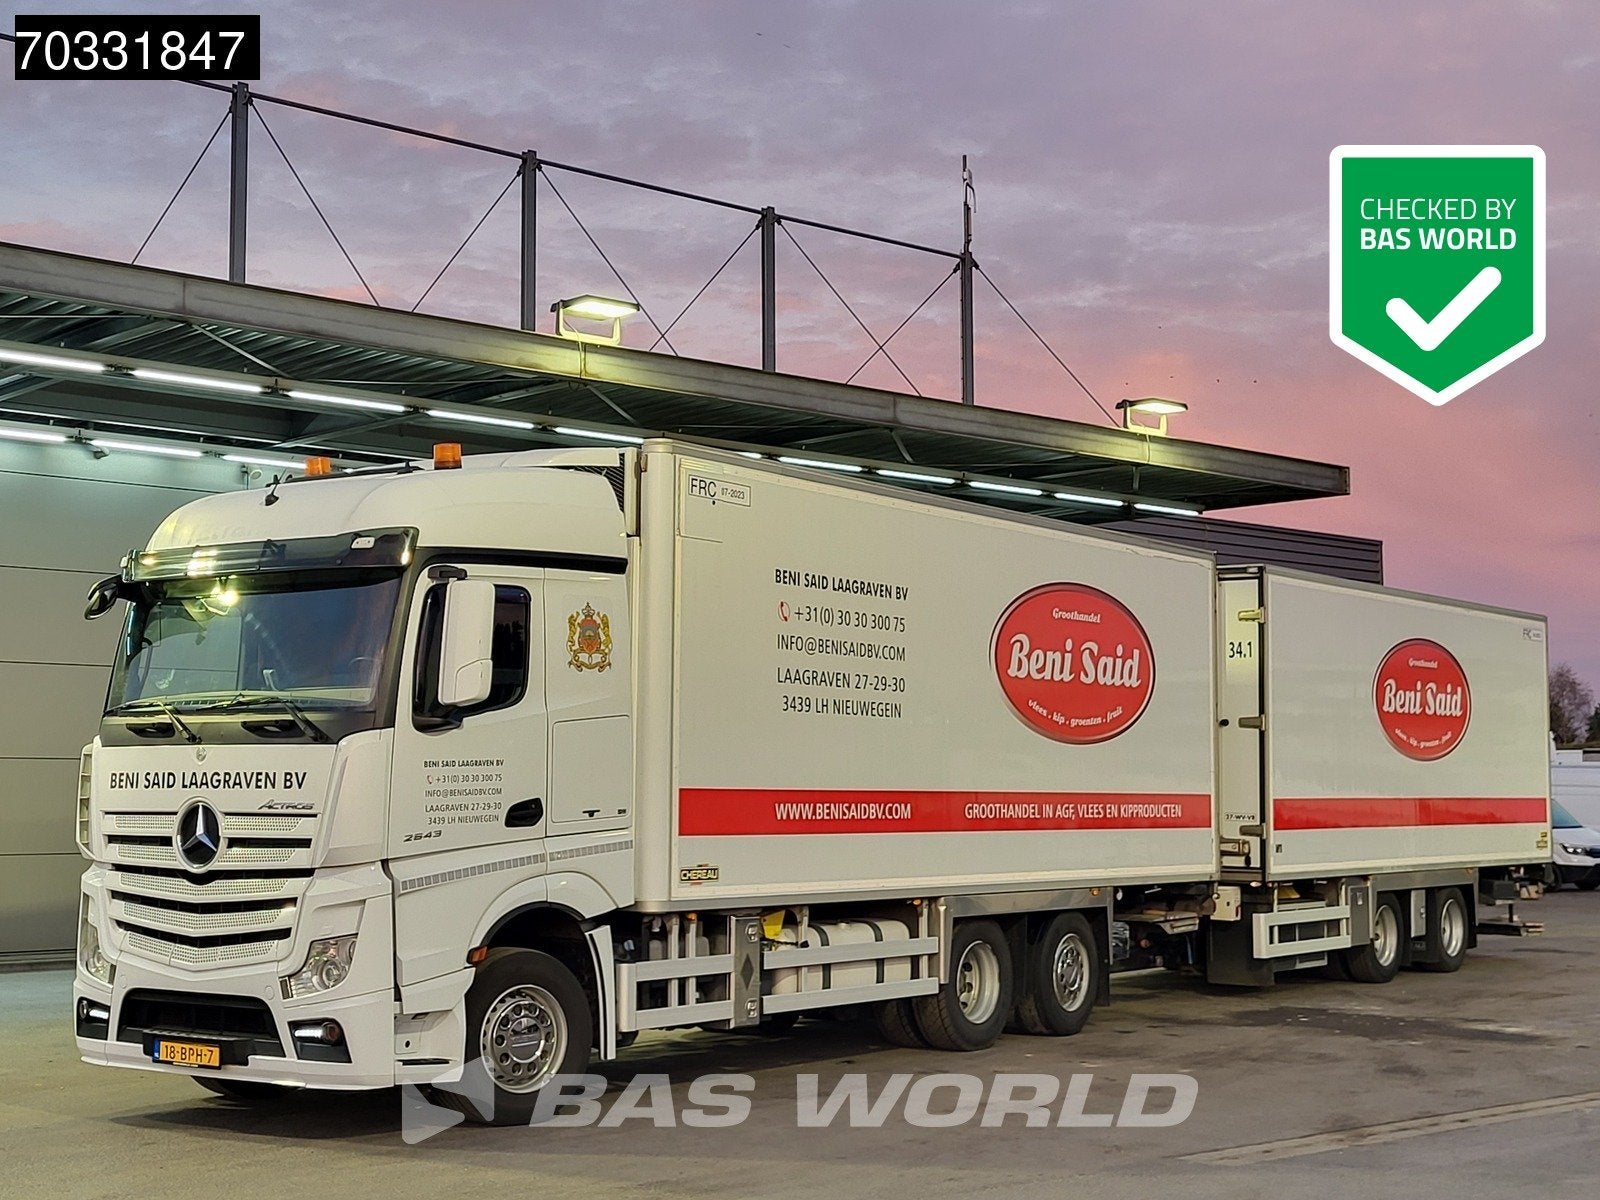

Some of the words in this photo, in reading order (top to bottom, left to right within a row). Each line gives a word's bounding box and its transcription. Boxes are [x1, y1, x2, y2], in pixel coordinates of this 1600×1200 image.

[690, 478, 717, 498] FRC
[775, 568, 800, 586] BENI
[804, 572, 829, 590] SAID
[832, 577, 892, 598] LAAGRAVEN
[895, 586, 909, 601] BV
[794, 605, 834, 627] +31(0)
[837, 609, 851, 626] 30
[854, 612, 868, 628] 30
[870, 614, 891, 631] 300
[893, 616, 906, 632] 75
[1052, 607, 1101, 624] Groothandel
[777, 634, 906, 661] INFO@BENISAIDBV.COM
[1228, 641, 1252, 659] 34.1
[1007, 633, 1075, 683] Beni
[1079, 641, 1142, 688] Said
[776, 666, 851, 689] LAAGRAVEN
[854, 673, 906, 693] 27-29-30
[1382, 678, 1423, 715] Beni
[1425, 681, 1463, 717] Said
[782, 695, 812, 713] 3439
[815, 697, 829, 714] LH
[832, 699, 902, 719] NIEUWEGEIN
[423, 760, 440, 768] BENI
[441, 760, 457, 768] SAID
[457, 759, 495, 768] LAAGRAVEN
[496, 759, 505, 767] BV
[109, 772, 140, 790] BENI
[143, 771, 177, 790] SAID
[181, 771, 277, 790] LAAGRAVEN
[283, 771, 307, 790] BV
[461, 774, 470, 783] 30
[471, 774, 480, 782] 30
[481, 773, 494, 782] 300
[495, 773, 503, 782] 75
[425, 788, 502, 798] INFO@BENISAIDBV.COM
[425, 804, 469, 812] LAAGRAVEN
[470, 802, 503, 811] 27-29-30
[774, 803, 912, 820] WWW.BENISAIDBV.COM
[964, 803, 1041, 819] GROOTHANDEL
[1042, 804, 1054, 819] IN
[1055, 804, 1075, 821] AGF,
[1077, 804, 1104, 819] VLEES
[1106, 804, 1118, 818] EN
[1120, 803, 1182, 819] KIPPRODUCTEN
[428, 817, 446, 826] 3439
[447, 816, 456, 825] LH
[457, 814, 500, 824] NIEUWEGEIN
[403, 830, 442, 843] 2643
[165, 1045, 214, 1063] 18-BPH-7
